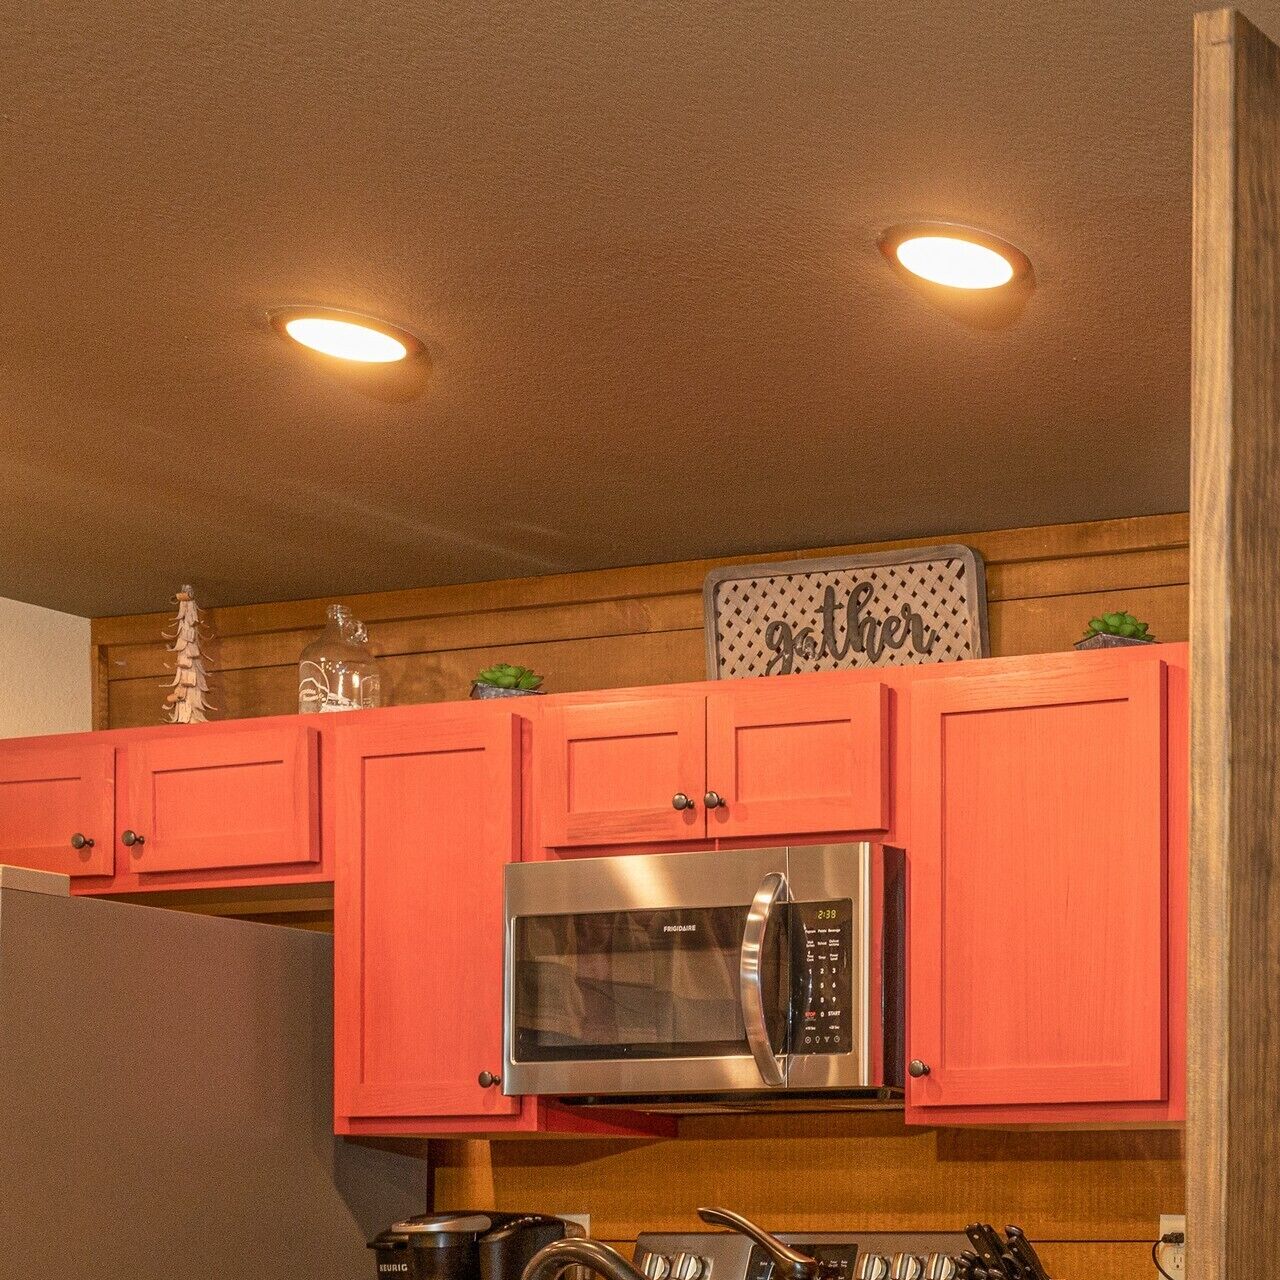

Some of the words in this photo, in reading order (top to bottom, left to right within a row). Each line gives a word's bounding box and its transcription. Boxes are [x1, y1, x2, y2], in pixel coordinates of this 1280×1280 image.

[765, 582, 937, 676] gather
[818, 910, 836, 919] 2:38
[380, 1264, 408, 1272] KEURIG
